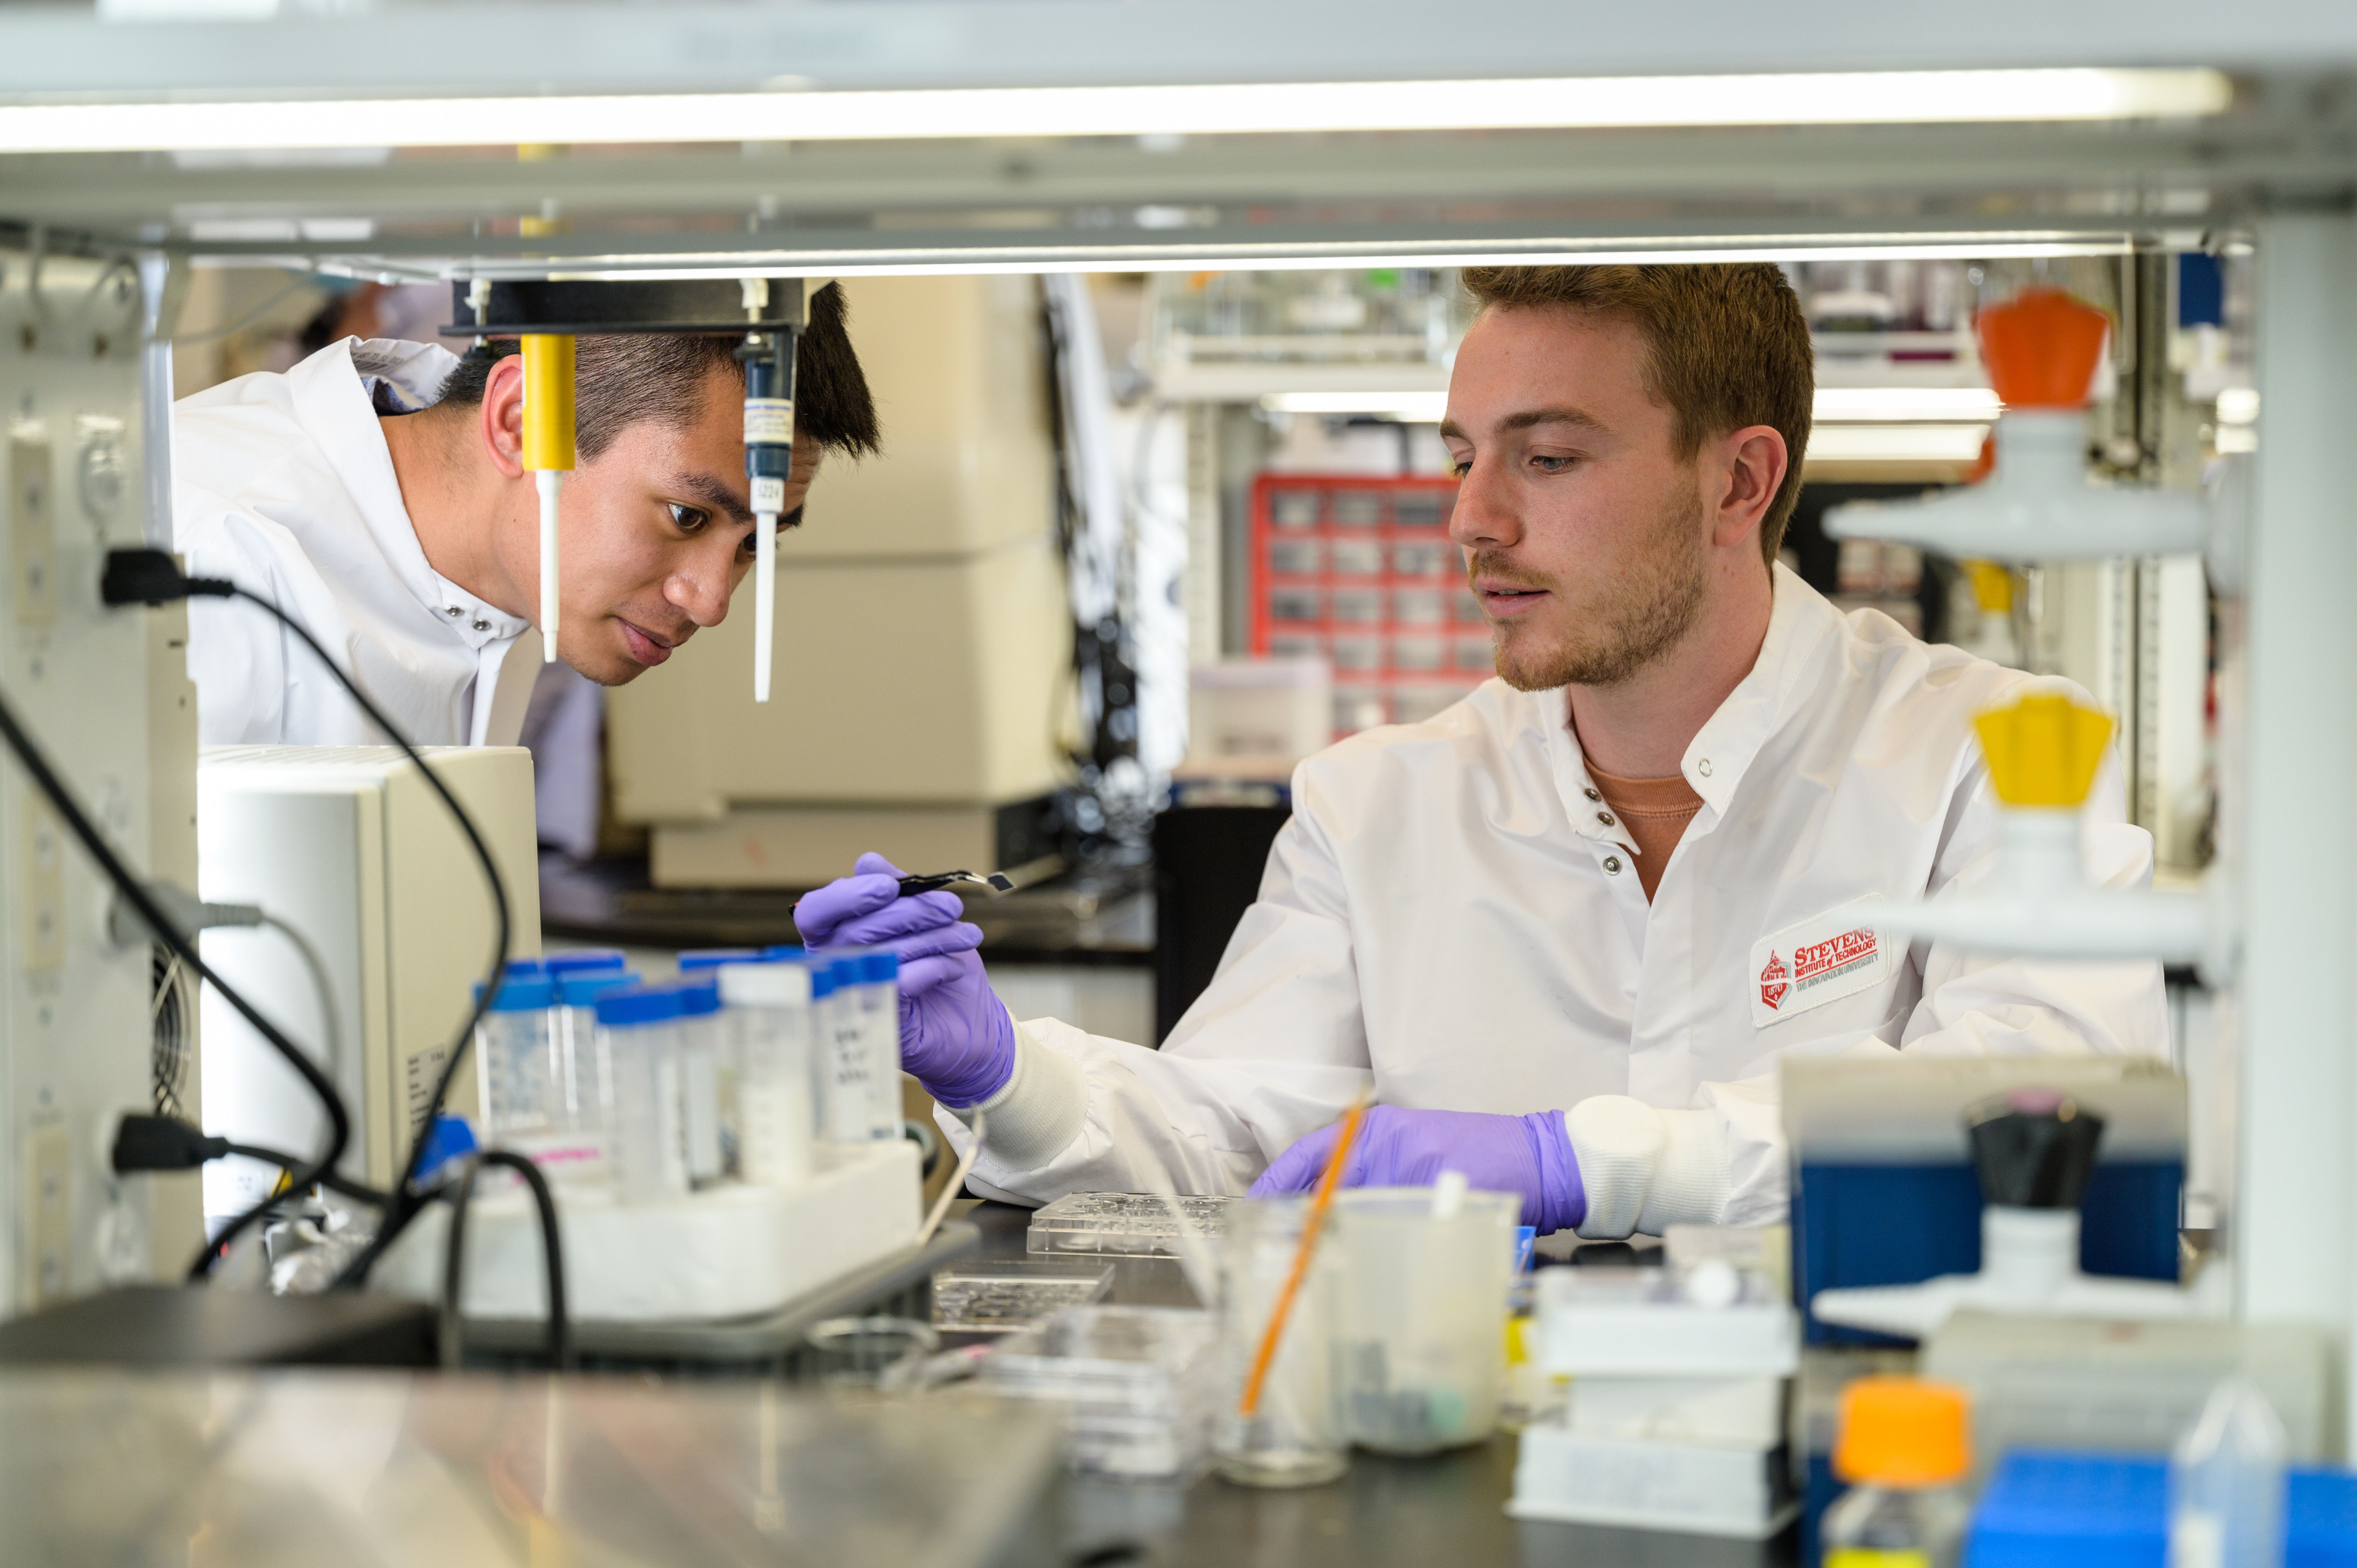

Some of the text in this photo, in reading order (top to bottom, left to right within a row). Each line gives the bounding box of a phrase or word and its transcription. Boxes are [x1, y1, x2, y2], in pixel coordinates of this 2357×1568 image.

[1795, 924, 1875, 967] STEVENS
[1795, 938, 1876, 978] INSTITUTE of TECHNOLOGY
[1767, 983, 1783, 996] 1870
[1796, 952, 1879, 992] THE INNOVATION UNIVERSITY
